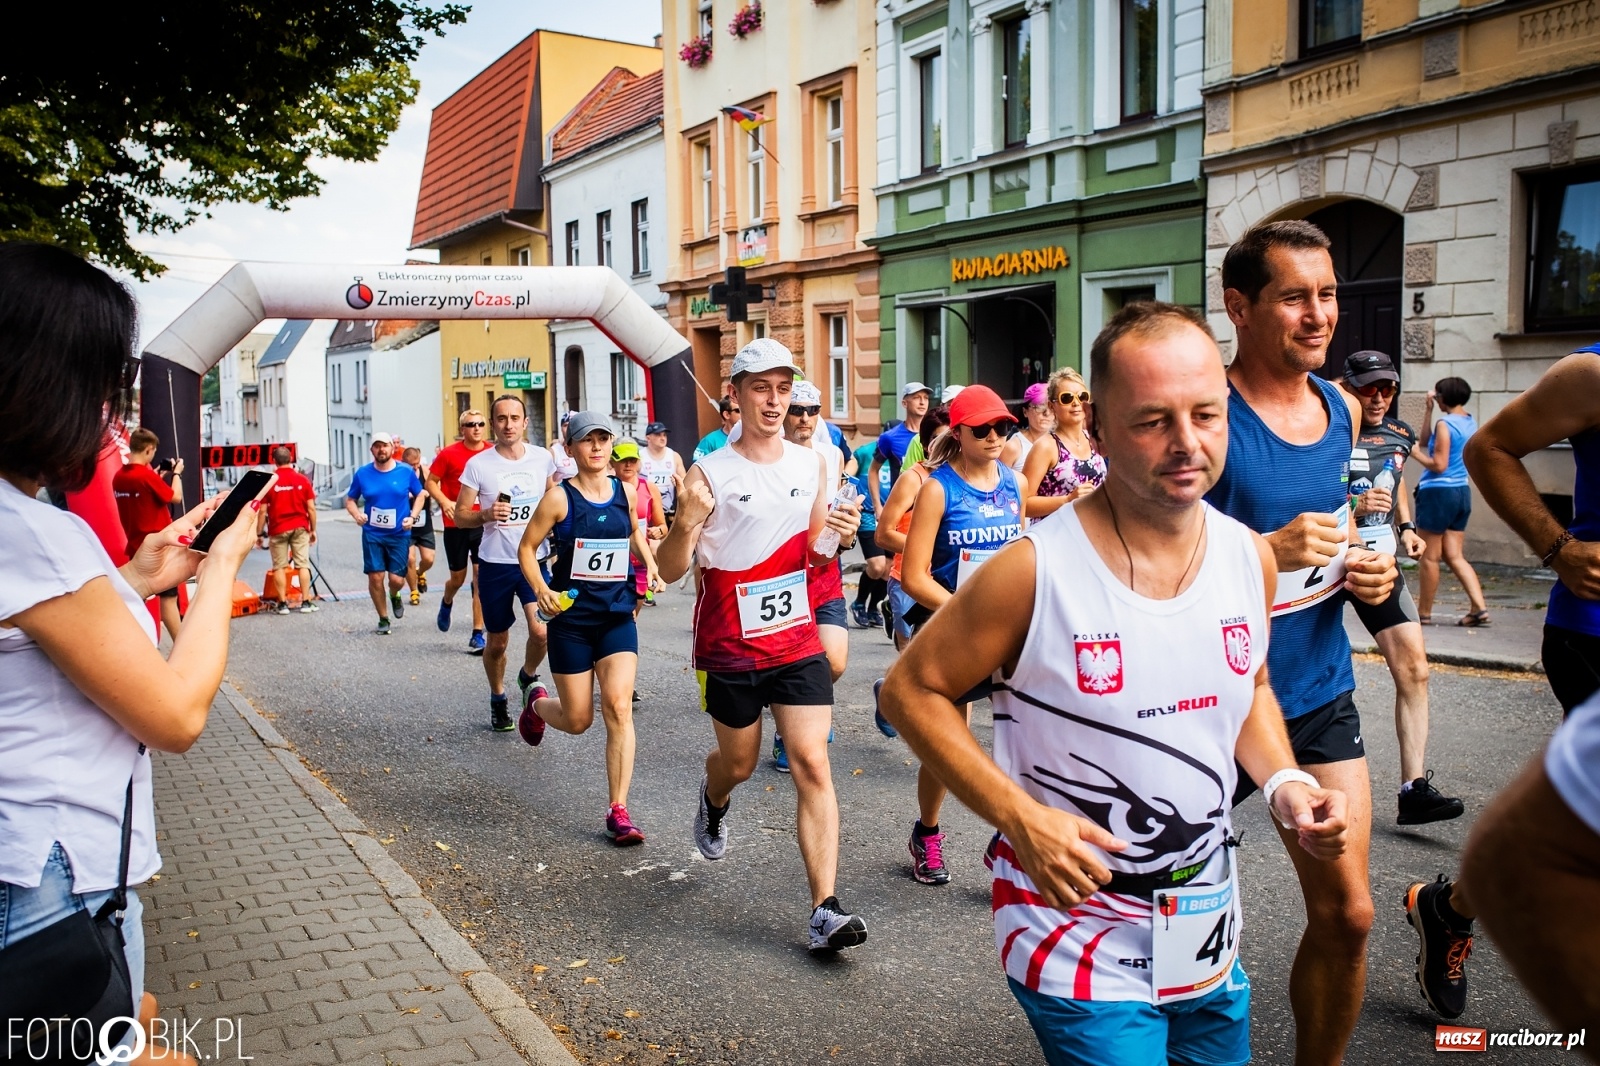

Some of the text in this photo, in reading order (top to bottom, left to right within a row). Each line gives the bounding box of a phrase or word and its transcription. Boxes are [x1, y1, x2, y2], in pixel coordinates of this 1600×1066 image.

[952, 246, 1069, 282] KWIACIARNIA
[378, 271, 523, 283] Elektroniczny pomiar czasu
[377, 290, 530, 310] ZmierzymyCzas.pl
[1413, 291, 1425, 314] 5
[210, 446, 223, 468] 0
[233, 445, 260, 466] 00
[654, 475, 666, 484] 21
[376, 514, 389, 524] 55
[509, 505, 530, 521] 58
[588, 552, 614, 571] 61
[760, 590, 792, 622] 53
[1073, 632, 1120, 641] POLSKA
[1181, 900, 1187, 911] I
[1189, 896, 1219, 911] BIEG
